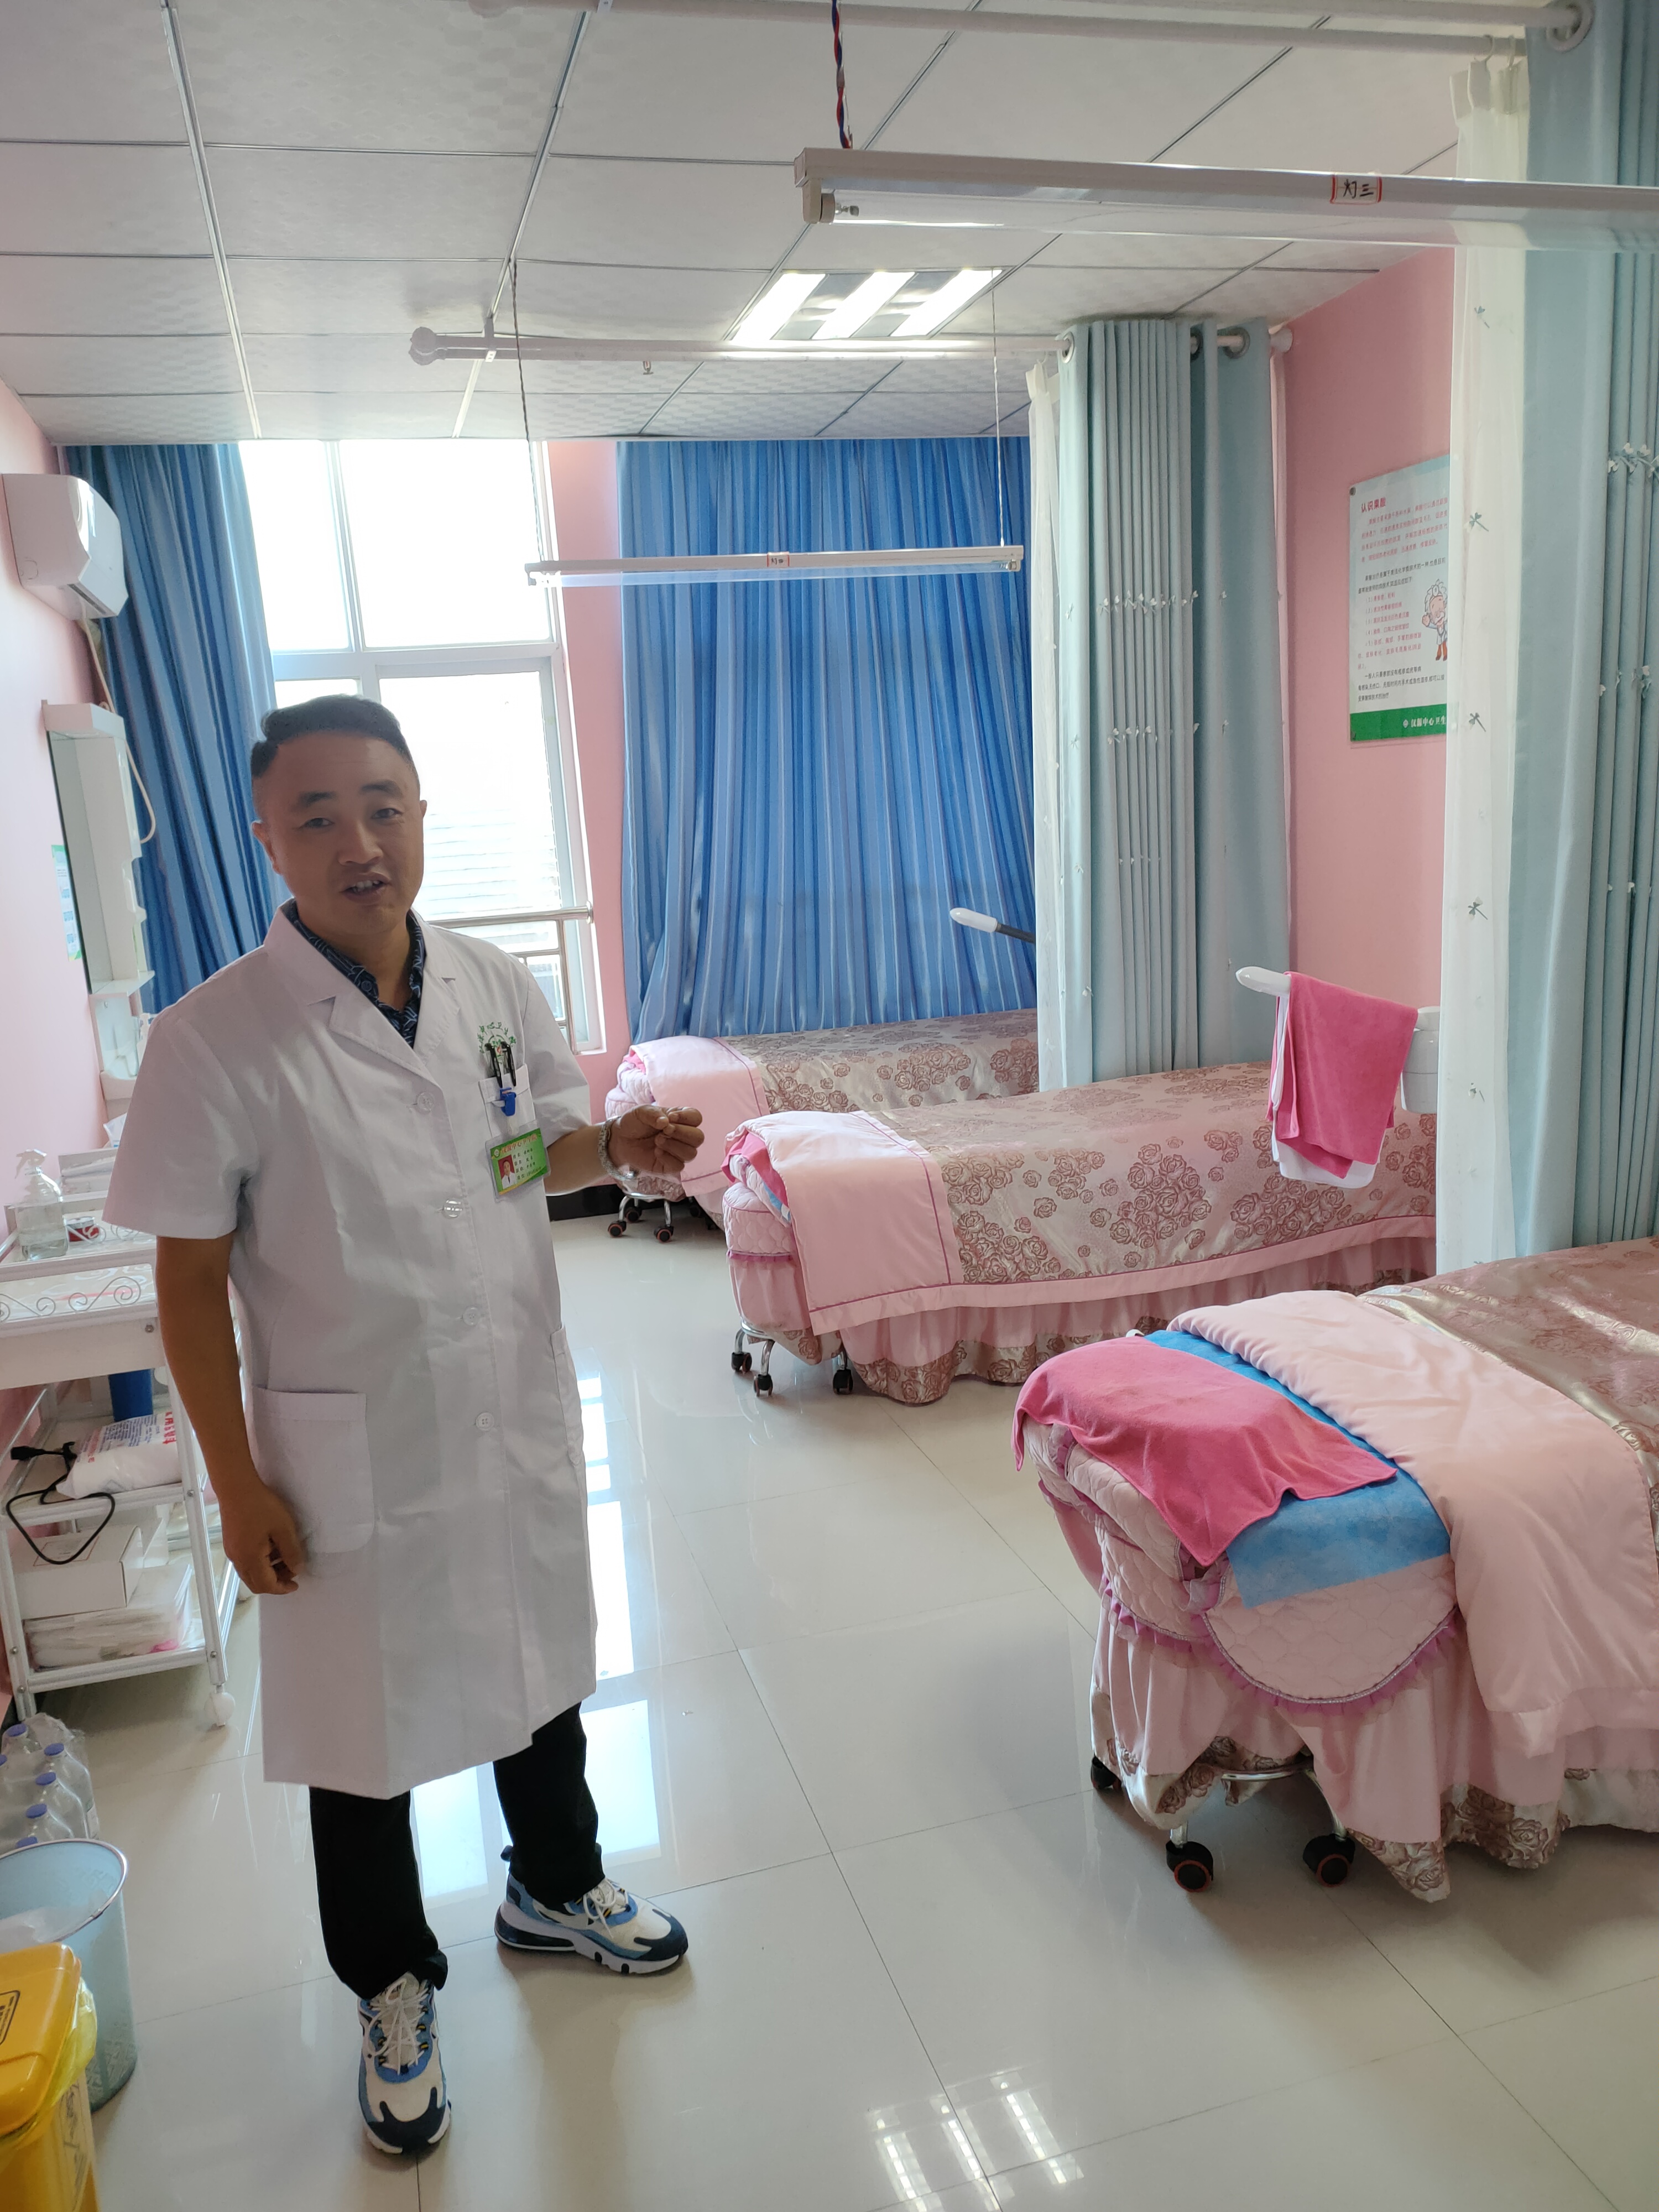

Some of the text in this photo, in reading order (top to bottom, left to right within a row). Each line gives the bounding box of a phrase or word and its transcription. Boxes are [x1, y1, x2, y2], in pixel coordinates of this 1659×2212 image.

[1343, 179, 1374, 199] 灯三
[1361, 496, 1386, 513] 认识果酸
